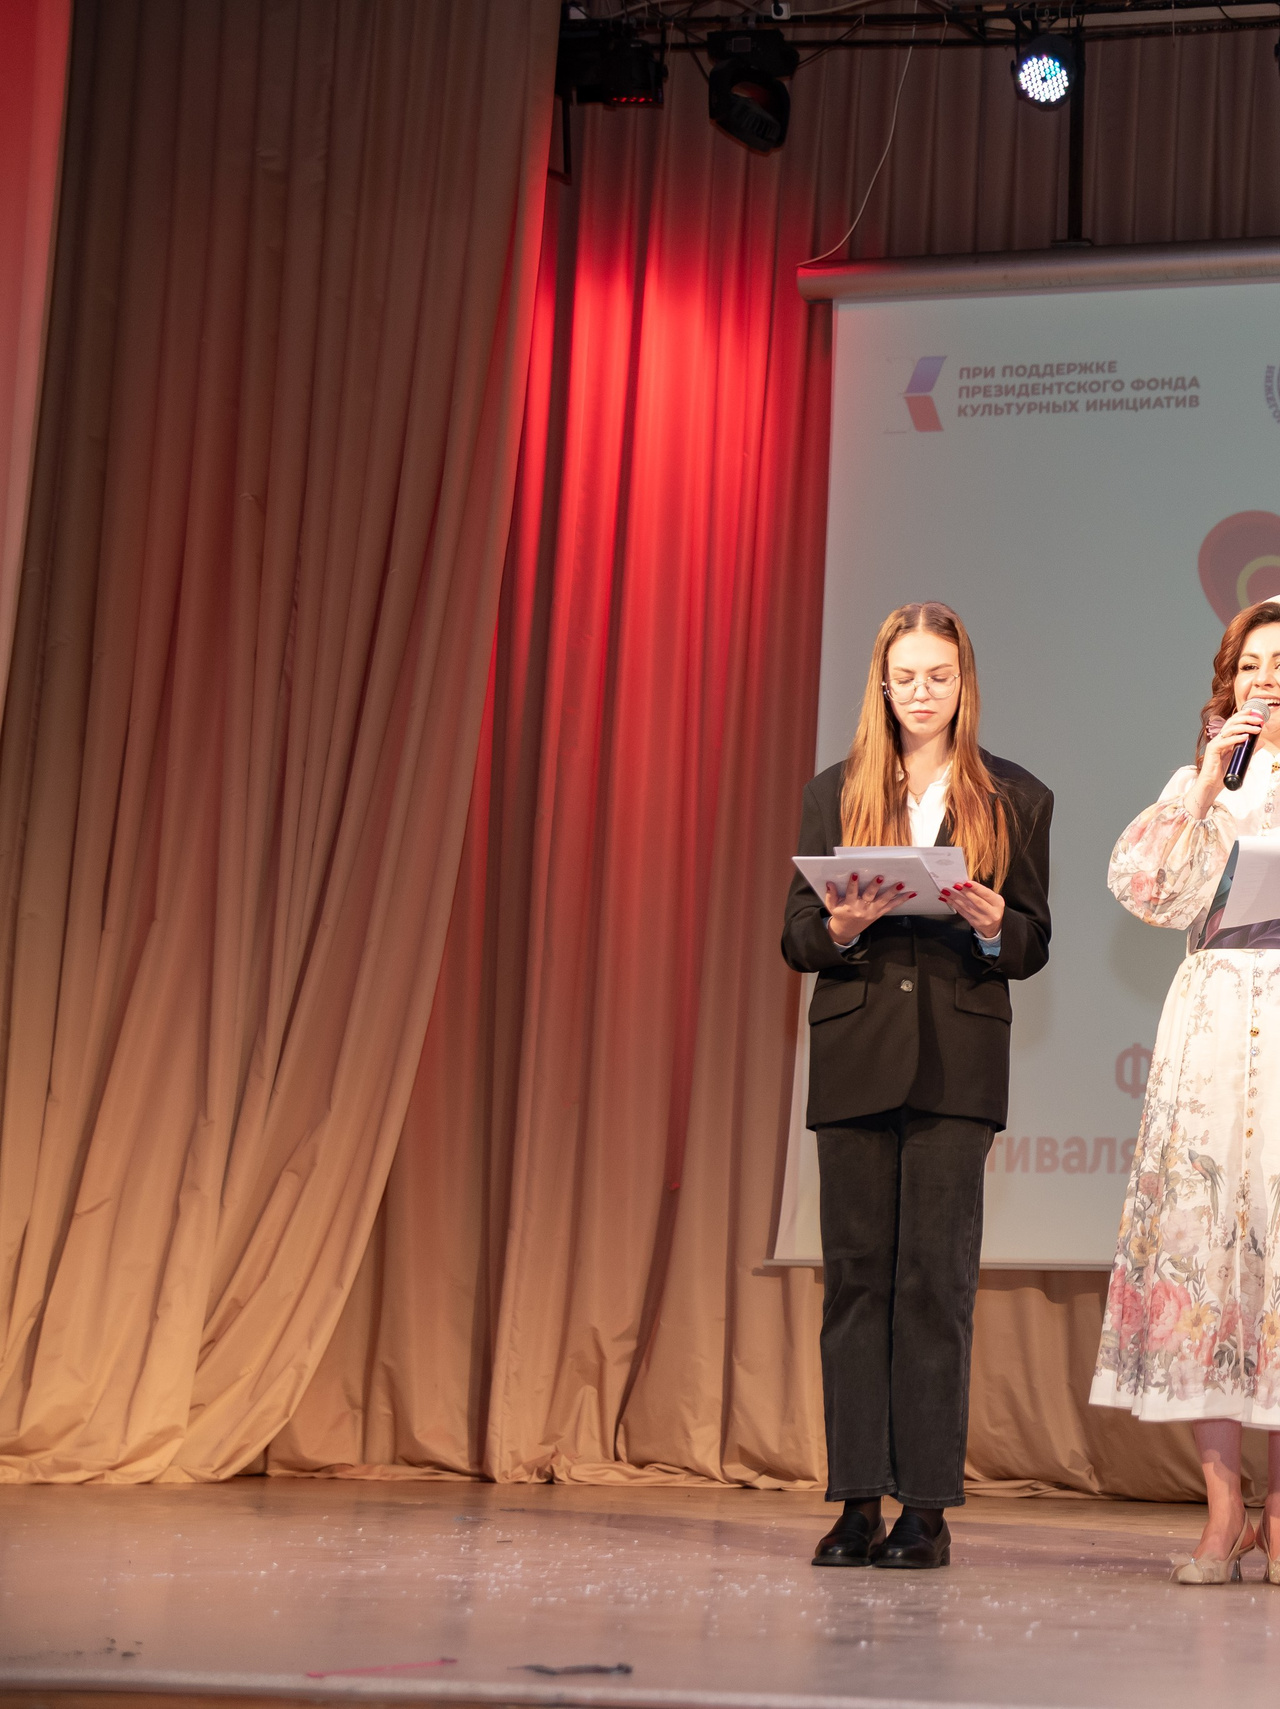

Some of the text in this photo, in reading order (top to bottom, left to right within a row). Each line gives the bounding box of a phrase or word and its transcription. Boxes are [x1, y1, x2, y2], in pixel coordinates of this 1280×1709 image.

[959, 360, 1118, 380] ПРИ ПОДДЕРЖКЕ
[958, 375, 1200, 399] ПРЕЗИДЕНТСКОГО ФОНДА
[958, 395, 1200, 418] КУЛЬТУРНЫХ ИНИЦИАТИВ
